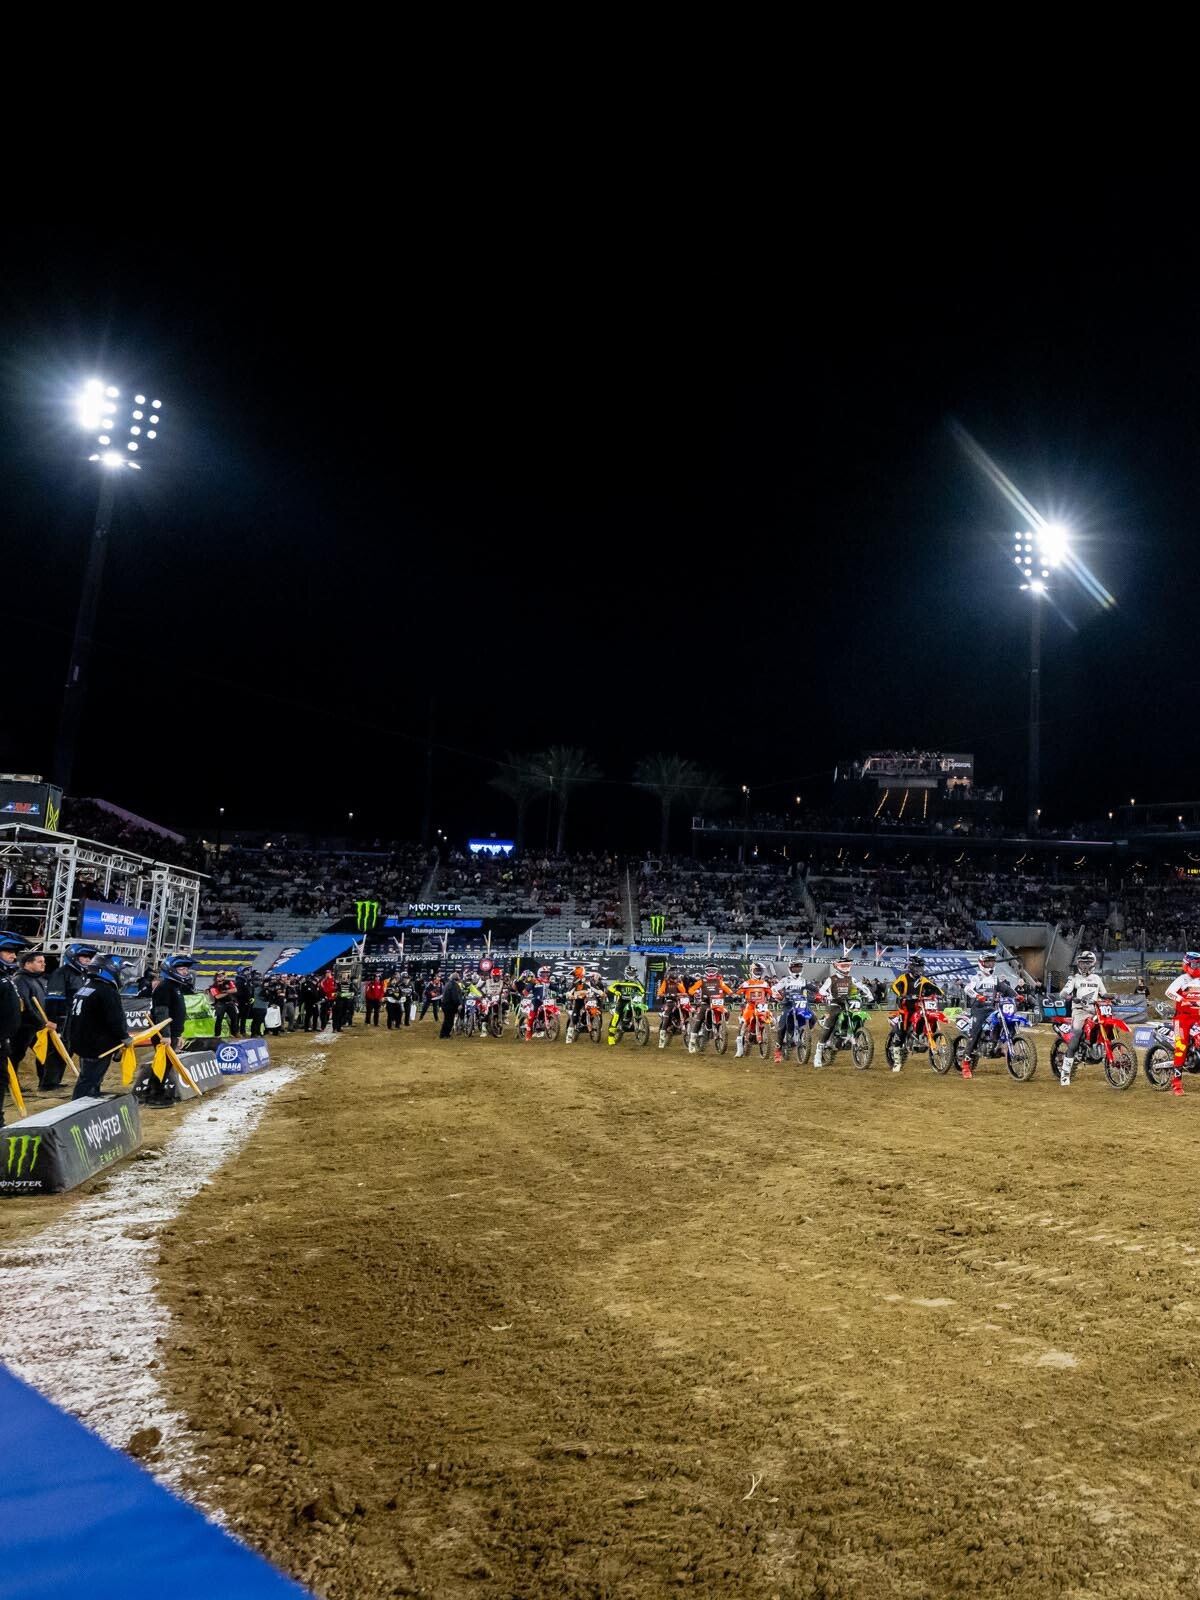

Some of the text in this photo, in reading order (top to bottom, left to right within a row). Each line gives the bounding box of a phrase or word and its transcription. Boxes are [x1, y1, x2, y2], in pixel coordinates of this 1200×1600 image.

[409, 903, 462, 912] MONSTER
[102, 912, 119, 922] COMING
[124, 916, 134, 926] NEXT
[411, 927, 456, 935] Championship
[1099, 1006, 1113, 1016] 102
[219, 1063, 242, 1071] AMAHA
[84, 1114, 122, 1150] MONSTER
